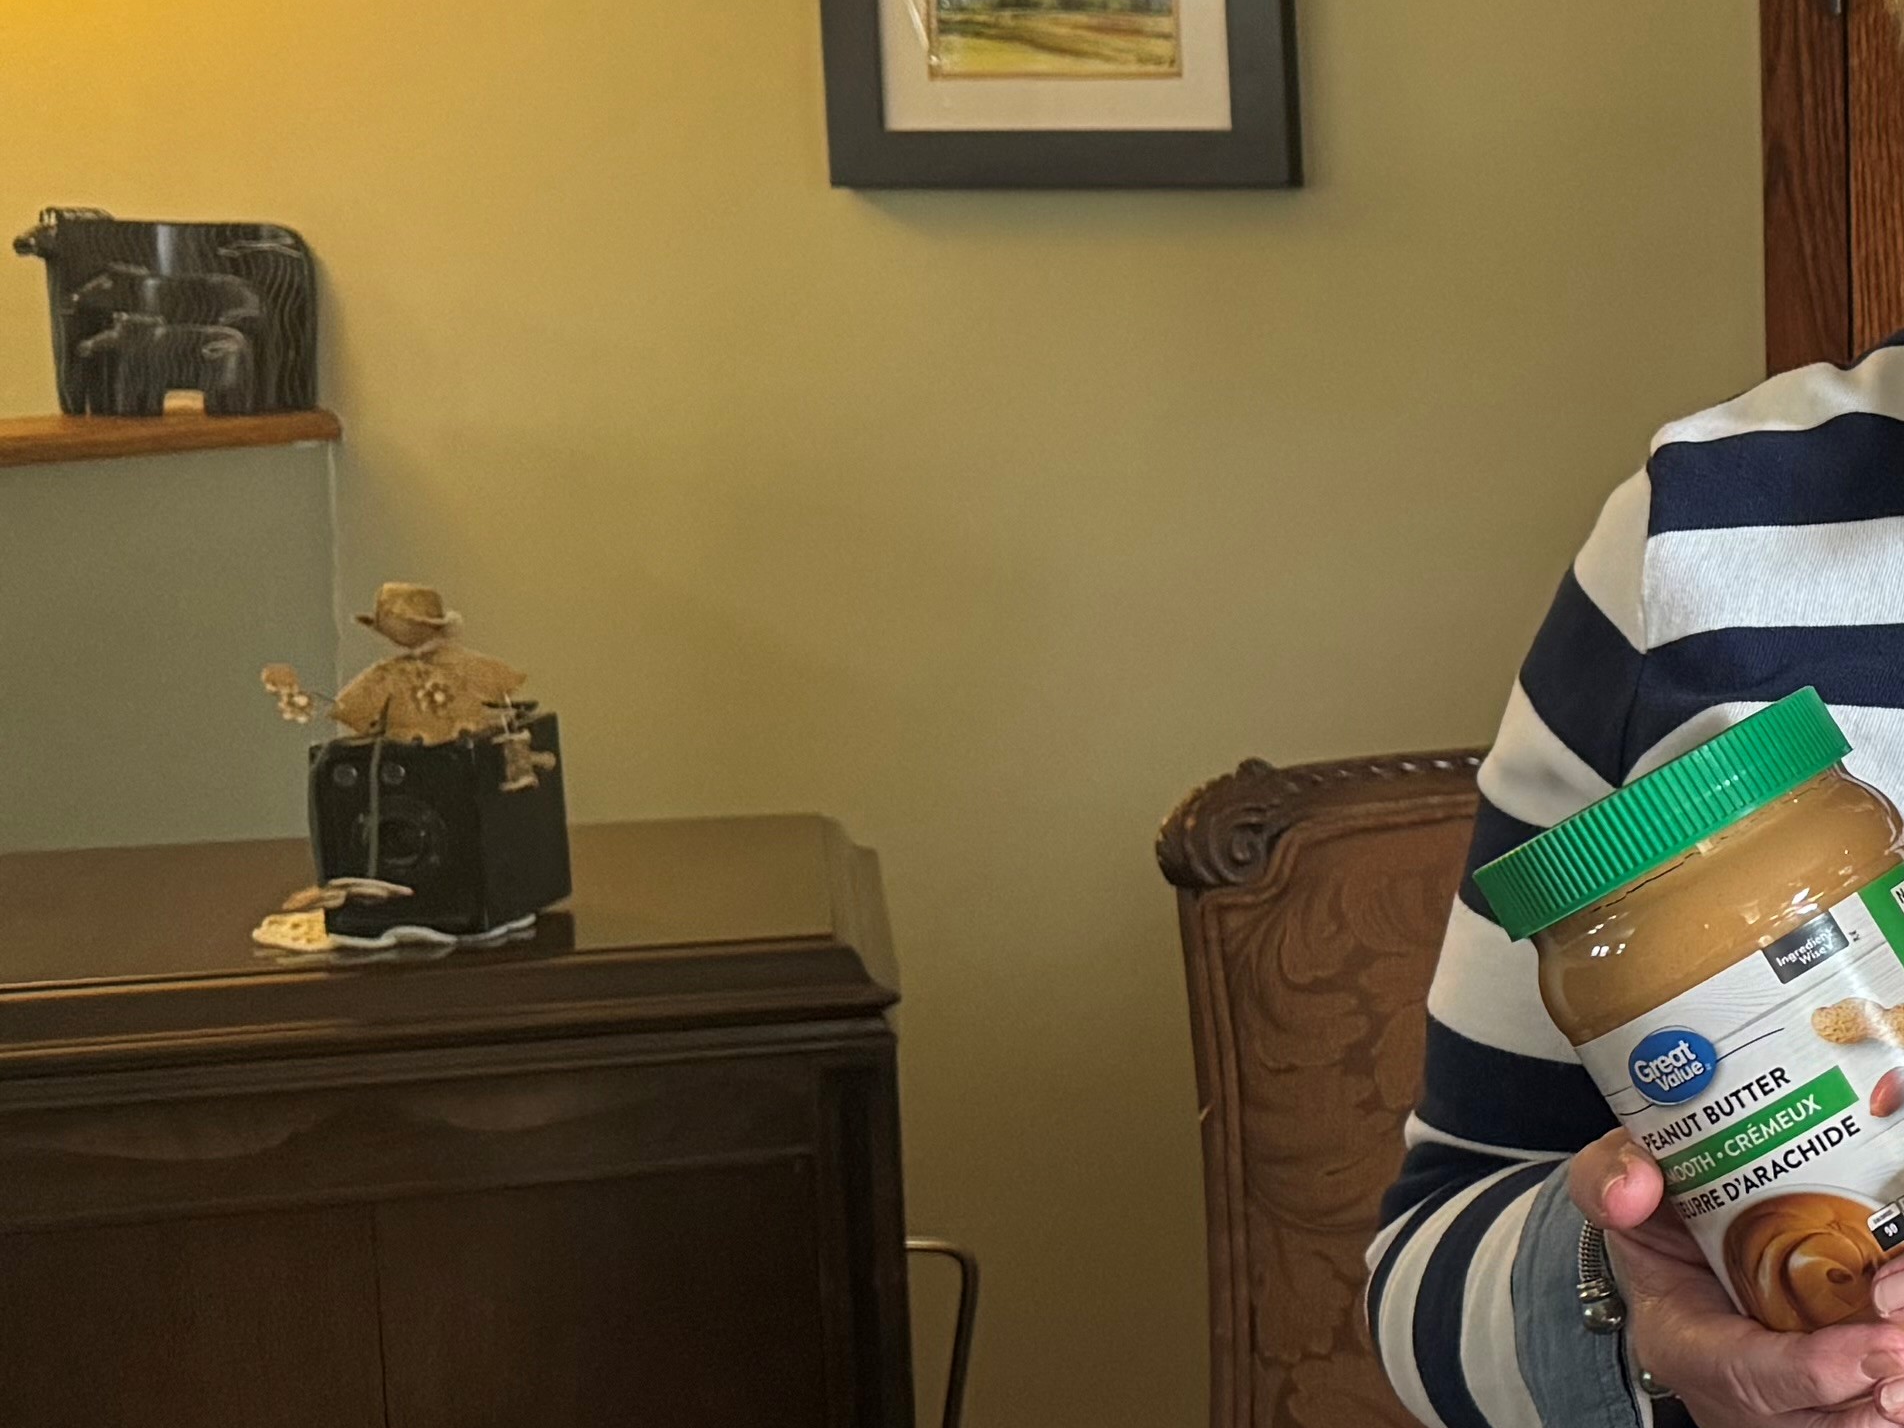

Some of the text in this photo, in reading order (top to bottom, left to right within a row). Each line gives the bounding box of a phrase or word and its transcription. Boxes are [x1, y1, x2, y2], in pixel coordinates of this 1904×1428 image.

[1633, 1040, 1697, 1084] Great
[1655, 1060, 1705, 1092] Value
[1641, 1066, 1791, 1153] PEANUT BUTTER
[1664, 1093, 1822, 1184] MOOTH CRÉMEUX
[1722, 1114, 1861, 1202] D'ARACHIDE
[1884, 1222, 1899, 1237] 90
